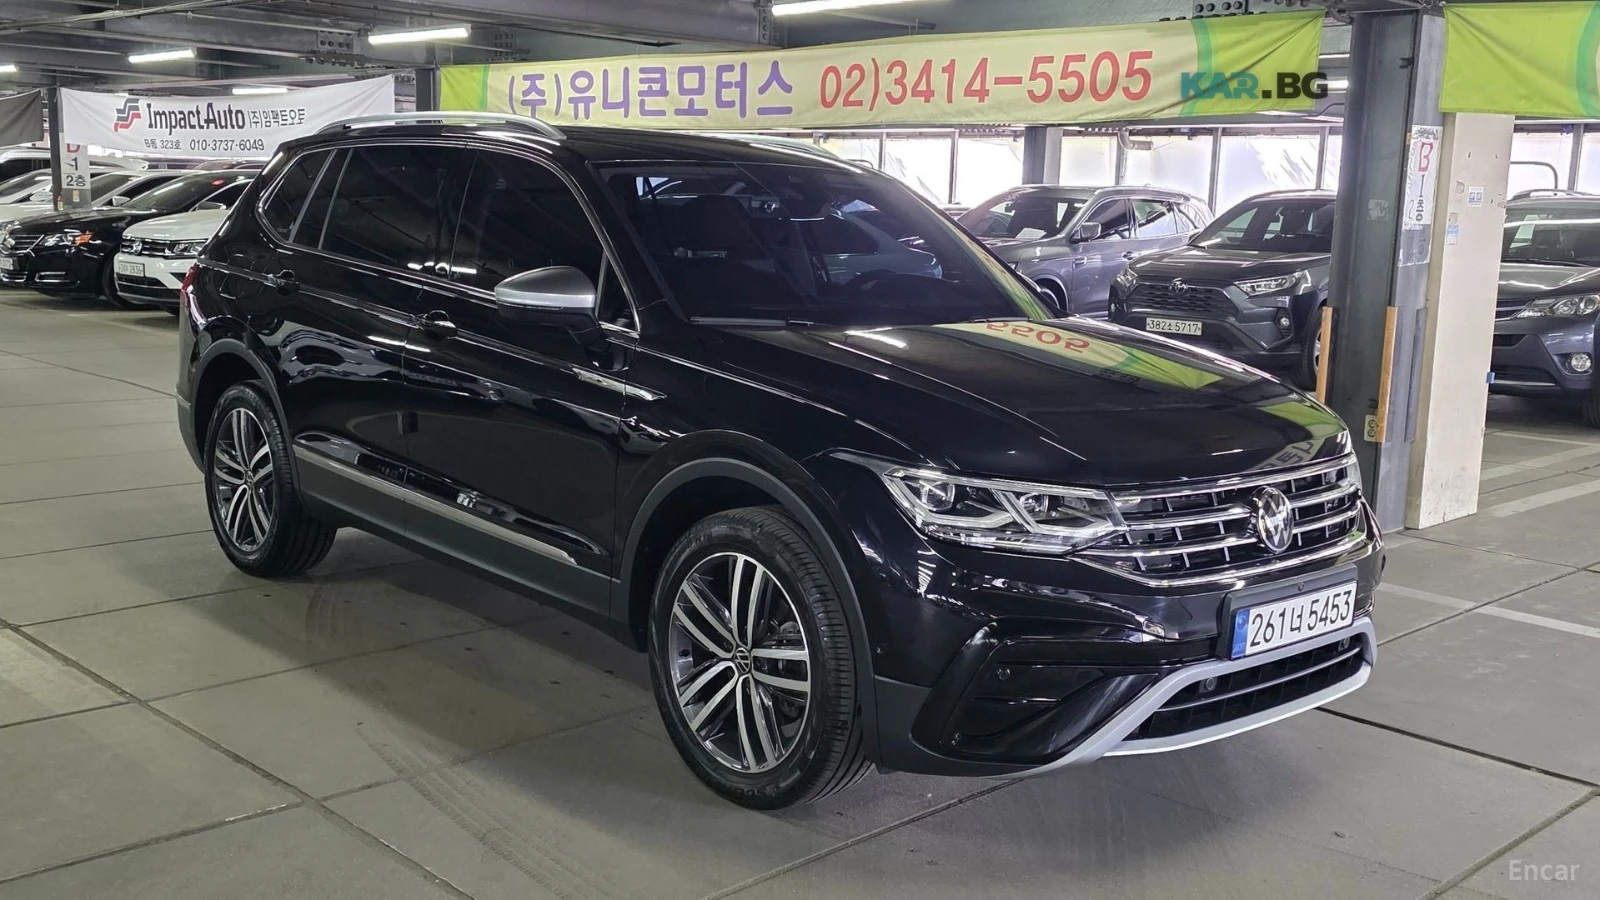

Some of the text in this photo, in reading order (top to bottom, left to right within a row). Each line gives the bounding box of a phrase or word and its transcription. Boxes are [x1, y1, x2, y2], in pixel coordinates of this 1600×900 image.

[508, 50, 1154, 121] (주)유니콘모터스 02)3414-5505
[1418, 142, 1434, 172] B
[66, 175, 86, 188] 2층
[1307, 590, 1353, 632] 5453
